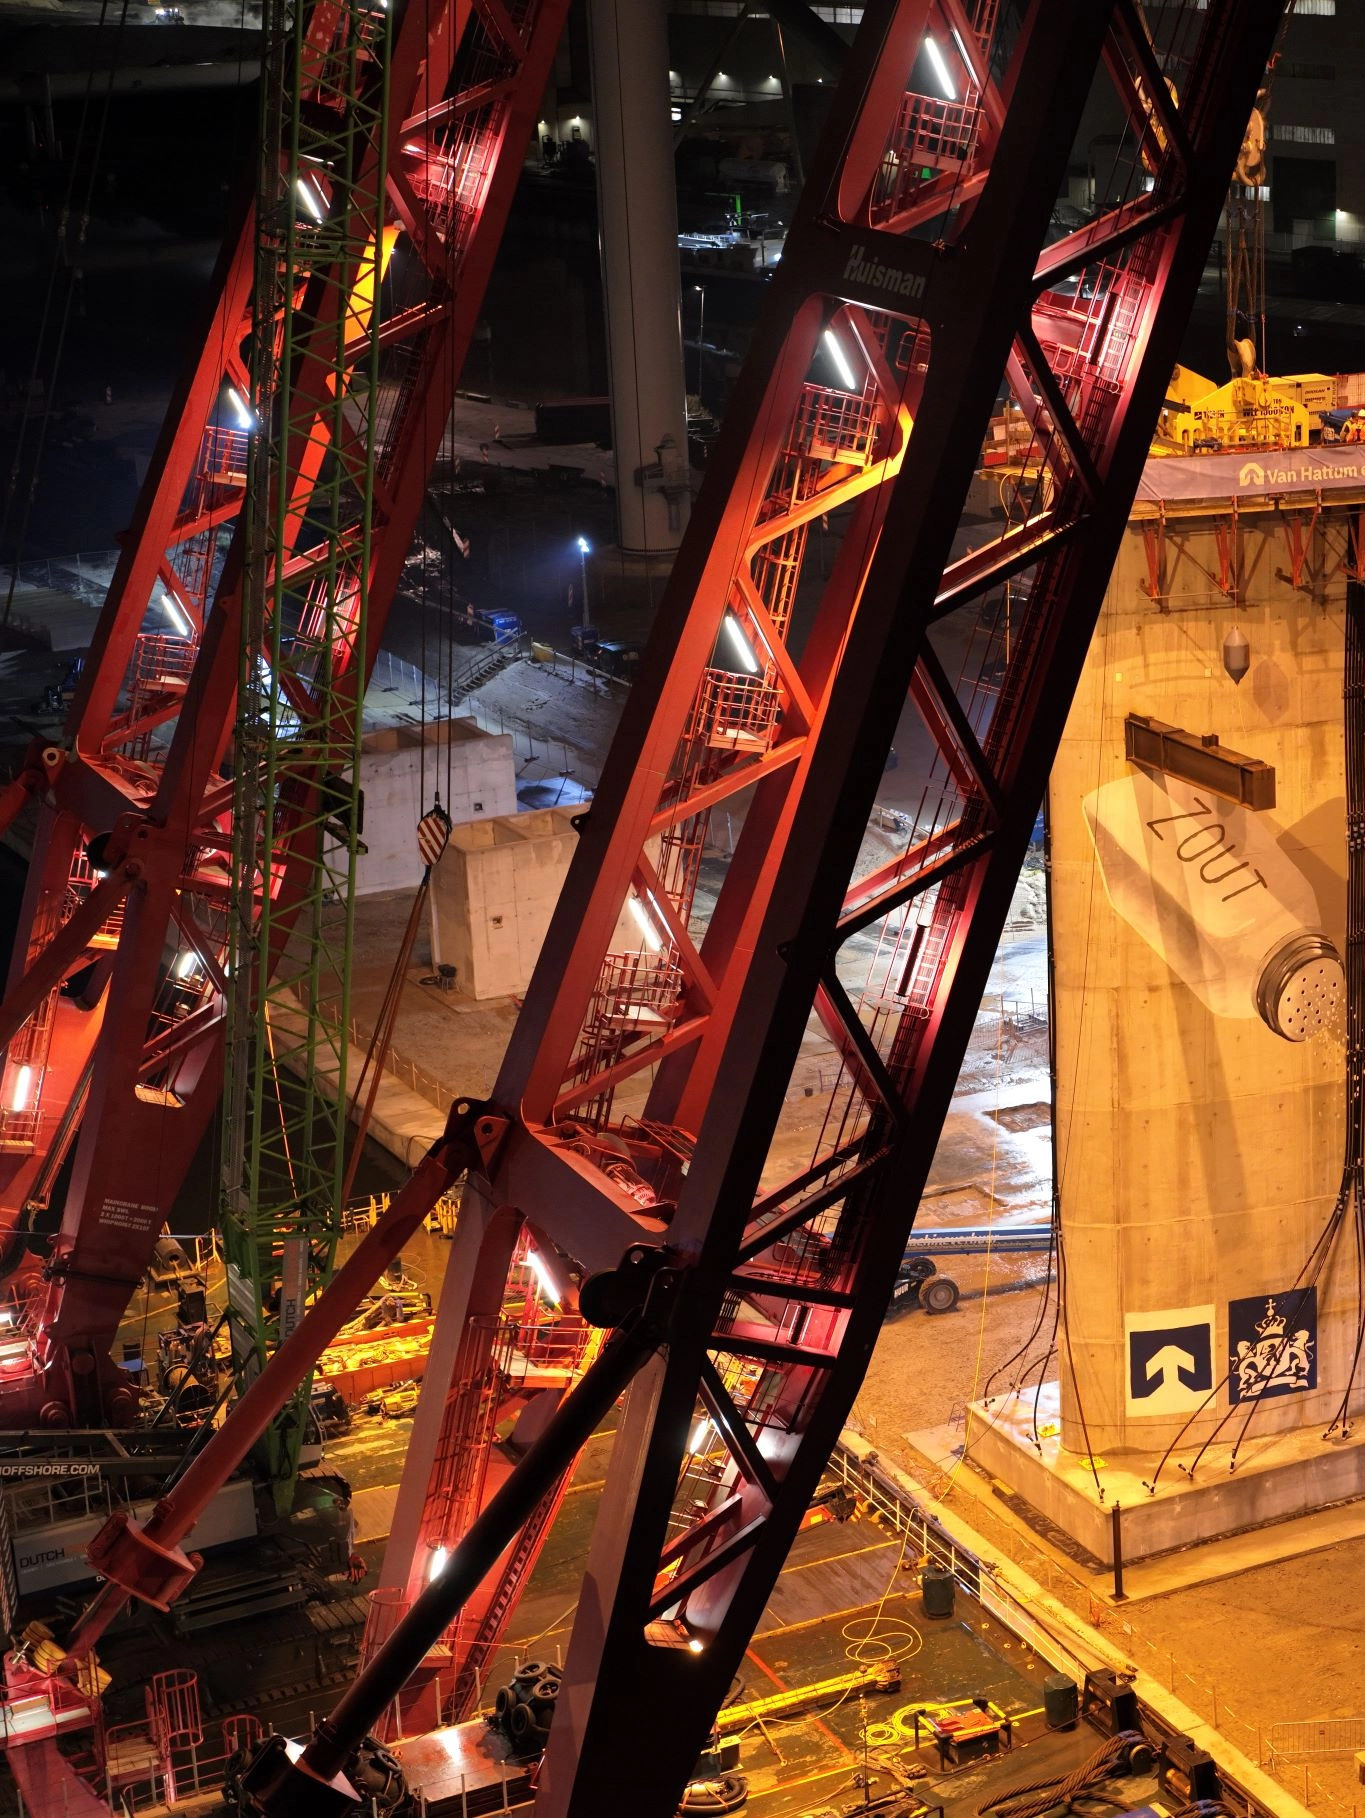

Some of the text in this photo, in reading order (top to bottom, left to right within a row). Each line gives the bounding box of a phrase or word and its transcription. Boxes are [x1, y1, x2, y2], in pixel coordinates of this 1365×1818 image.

[842, 244, 927, 299] Huisman
[1267, 469, 1297, 484] Van
[1301, 465, 1358, 482] Hattum
[1146, 796, 1268, 902] ZOUT
[102, 1204, 116, 1212] MAX
[0, 1464, 100, 1476] OFFSHORE.COM
[20, 1547, 65, 1569] DUTCH
